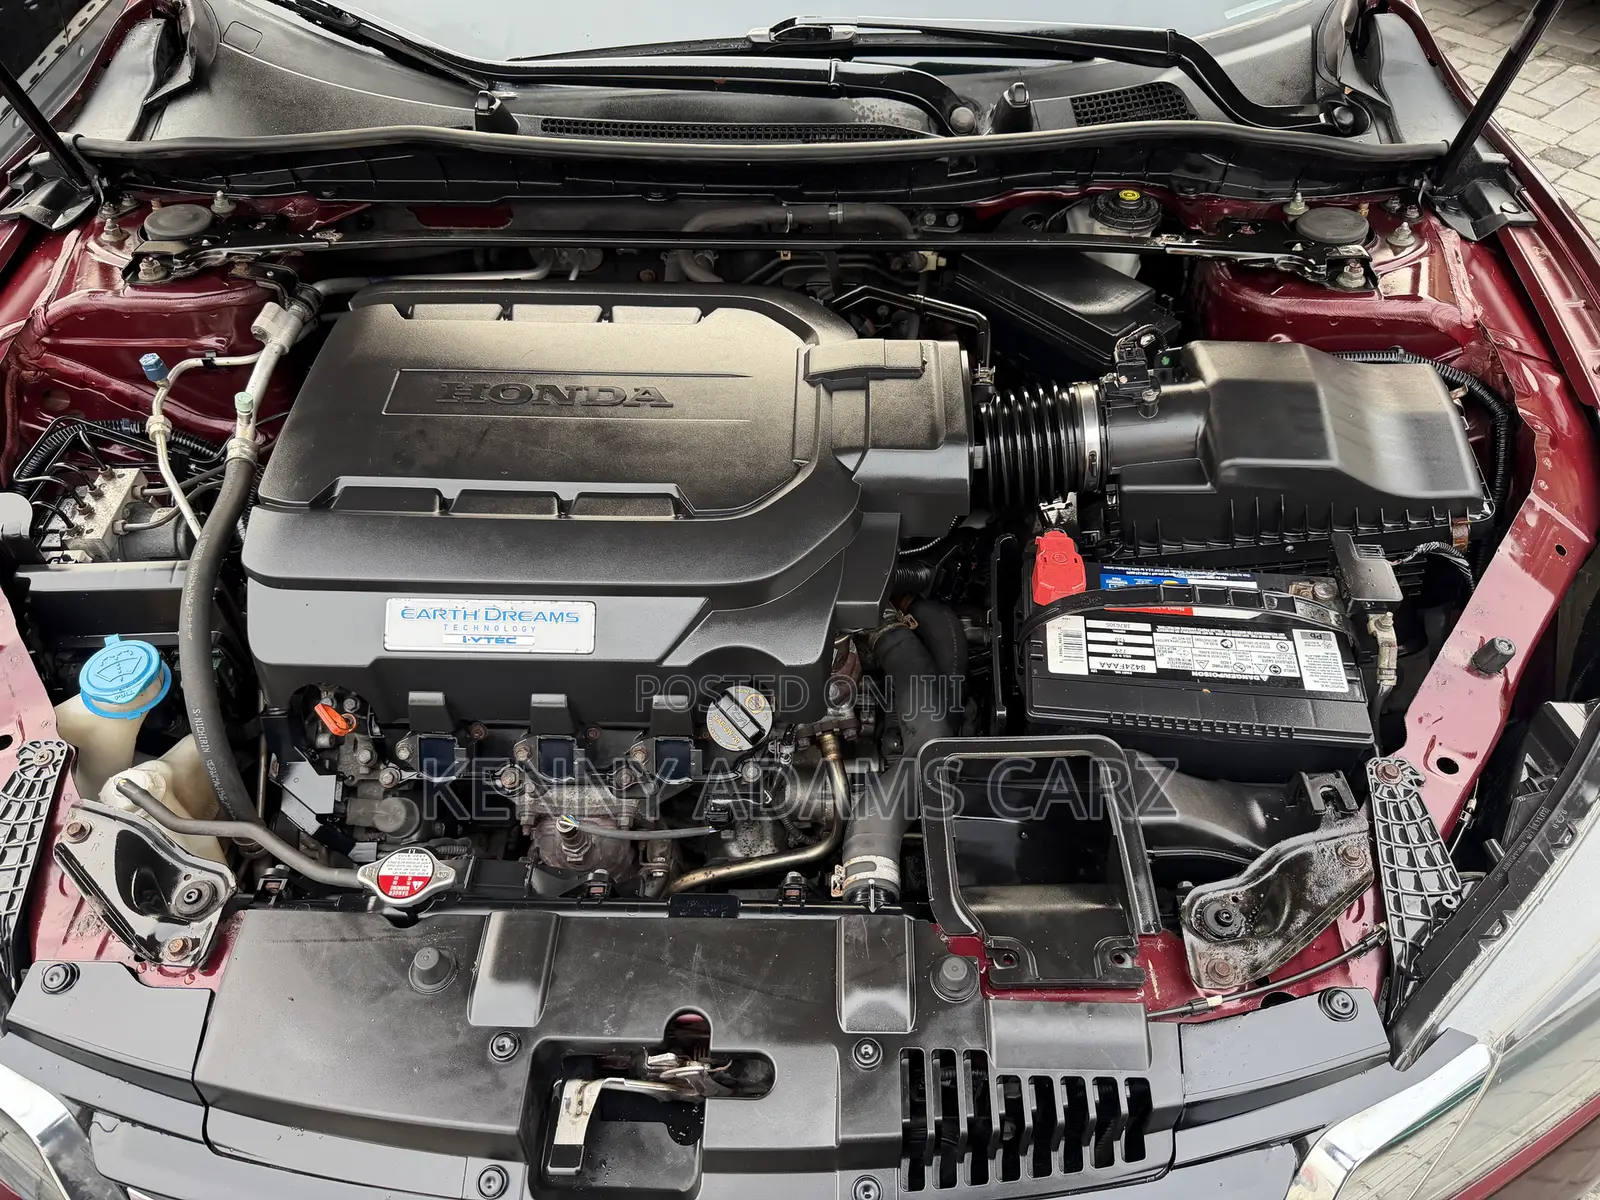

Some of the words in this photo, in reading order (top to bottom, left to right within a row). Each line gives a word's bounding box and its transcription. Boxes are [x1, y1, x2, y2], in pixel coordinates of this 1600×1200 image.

[436, 381, 674, 408] HONDA
[400, 606, 480, 621] EARTH
[484, 607, 580, 623] DREAMS
[444, 624, 536, 632] TECHNOLOGY
[1099, 662, 1146, 671] 8424FAAA
[1192, 671, 1260, 680] DANGER/POISON
[713, 714, 726, 728] SAE
